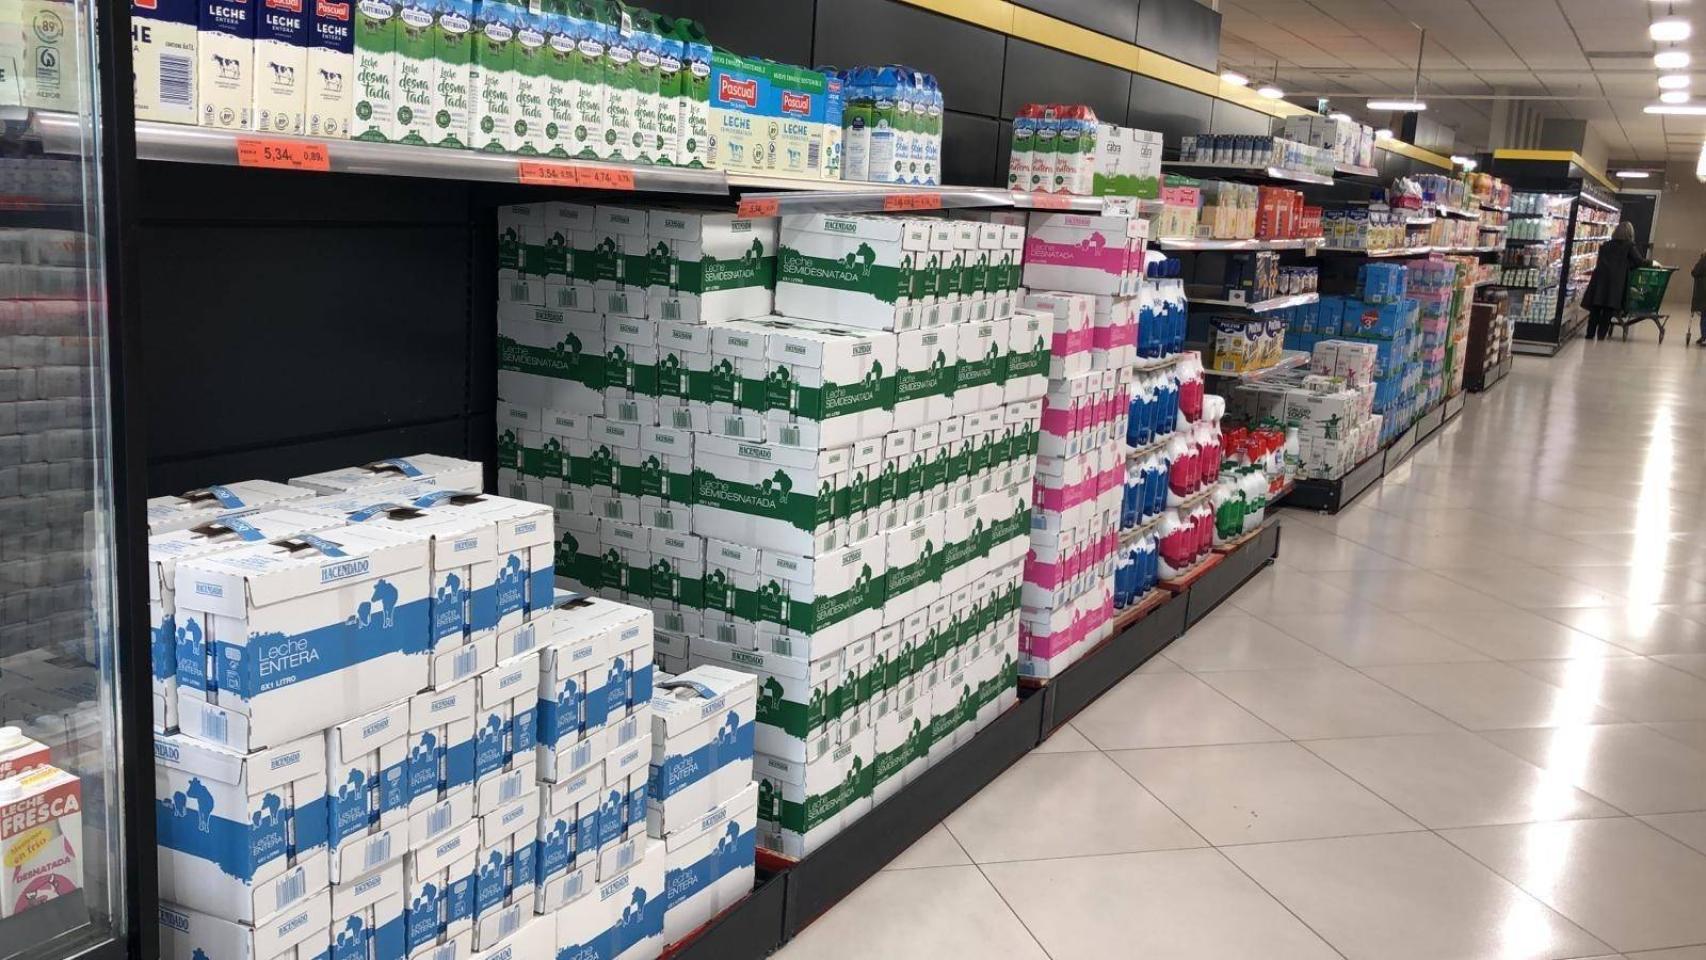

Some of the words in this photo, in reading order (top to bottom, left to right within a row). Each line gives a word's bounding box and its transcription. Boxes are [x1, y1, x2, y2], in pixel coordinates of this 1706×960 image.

[209, 5, 246, 20] LECHE
[216, 16, 239, 25] ENTERA
[266, 14, 300, 29] LECHE
[316, 22, 348, 37] LECHE
[358, 69, 389, 83] desna
[399, 75, 428, 91] desna
[364, 83, 390, 100] tada
[438, 80, 466, 95] desna
[482, 87, 508, 101] desna
[721, 80, 755, 99] Pascual
[402, 89, 430, 106] tada
[440, 94, 467, 110] tada
[516, 90, 541, 105] desna
[784, 95, 809, 110] Pascual
[486, 100, 510, 114] tada
[519, 104, 542, 119] tada
[550, 107, 572, 122] tada
[579, 110, 600, 124] tada
[723, 114, 751, 130] LECHE
[783, 124, 808, 136] LECHE
[824, 221, 856, 233] HACENDADO
[784, 255, 812, 267] Leche
[705, 269, 755, 282] SEMIDESNATADA
[783, 265, 859, 282] SEMIDESNATADA
[503, 353, 568, 370] SEMIDESNATADA
[899, 379, 938, 393] SEMIDESNATADA
[825, 391, 873, 408] SEMIDESNATADA
[738, 445, 772, 459] HACENDADO
[700, 486, 776, 510] SEMIDESNATADA
[321, 560, 369, 581] HACENDADO
[817, 597, 863, 622] SEMIDESNATADA
[258, 637, 308, 661] Leche
[259, 648, 320, 677] ENTERA
[731, 651, 764, 666] HACENDADO
[276, 675, 296, 687] LITRO
[363, 718, 389, 738] HACENDADO
[271, 752, 301, 770] HACENDADO
[670, 757, 693, 774] Leche
[669, 764, 699, 784] ENTERA
[2, 794, 45, 818] LECHE
[2, 794, 79, 838] FRESCA
[16, 855, 71, 884] DESNATADA
[355, 877, 382, 896] HACENDADO
[600, 875, 629, 899] HACENDADO
[667, 876, 699, 899] ENTERA
[669, 871, 693, 888] Leche
[279, 914, 308, 937] HACENDADO
